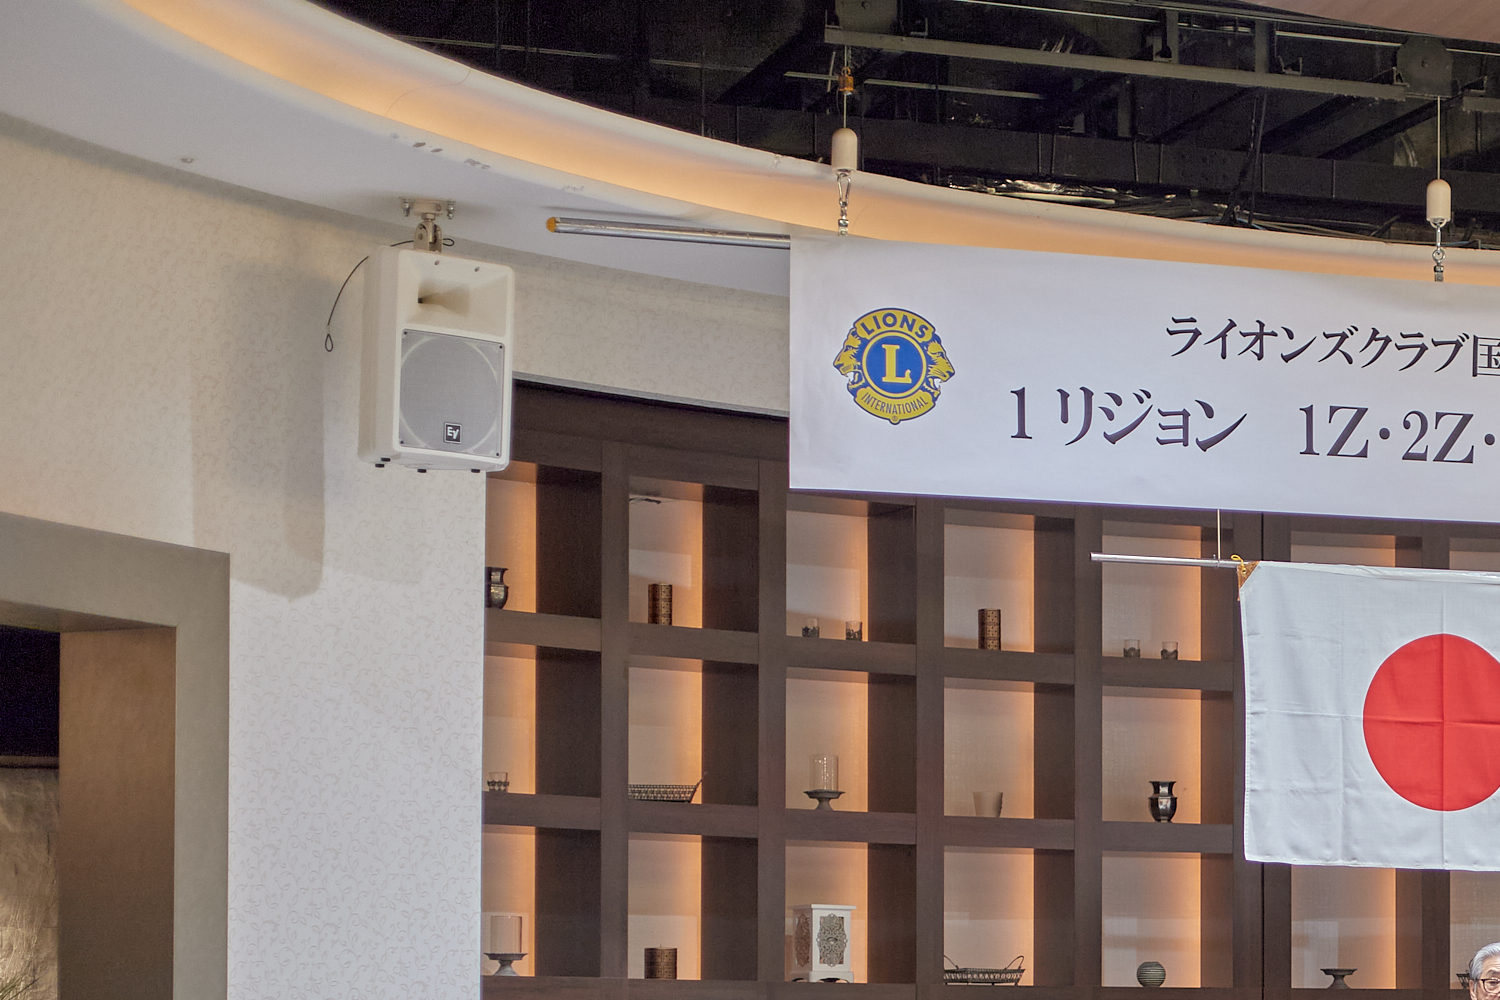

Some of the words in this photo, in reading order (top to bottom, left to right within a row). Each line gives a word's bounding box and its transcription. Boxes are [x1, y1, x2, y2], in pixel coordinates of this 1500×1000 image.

[860, 312, 929, 339] LIONS
[882, 344, 912, 383] L
[861, 392, 929, 415] INTERNATIONAL
